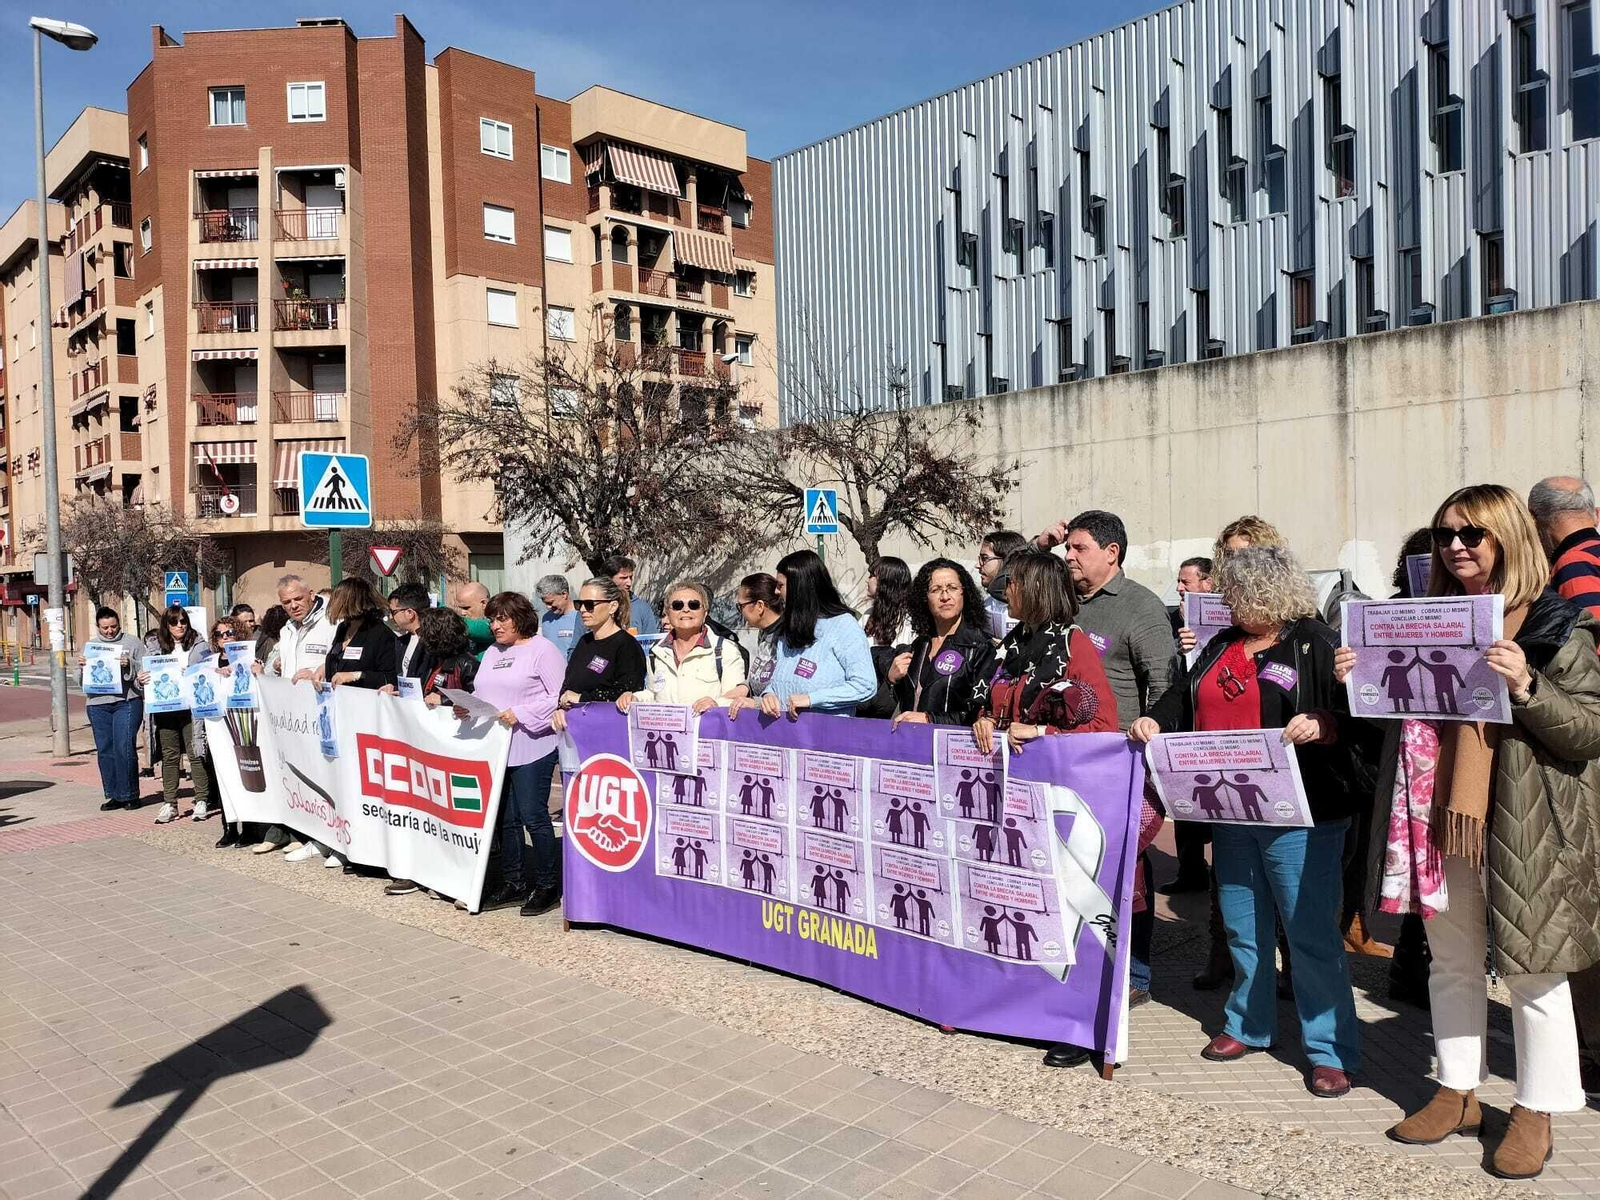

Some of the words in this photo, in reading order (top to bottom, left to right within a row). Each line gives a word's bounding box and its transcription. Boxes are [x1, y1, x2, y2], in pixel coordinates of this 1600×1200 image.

[937, 661, 956, 672] UGT
[365, 747, 449, 809] CCOO
[579, 774, 639, 821] UGT
[423, 817, 437, 836] de
[439, 822, 450, 843] la
[451, 832, 481, 855] muj
[991, 892, 1010, 900] MUJERES
[1016, 896, 1038, 905] HOMBRES
[1018, 890, 1040, 898] SALARIAL
[762, 899, 794, 935] UGT
[798, 909, 879, 960] GRANADA
